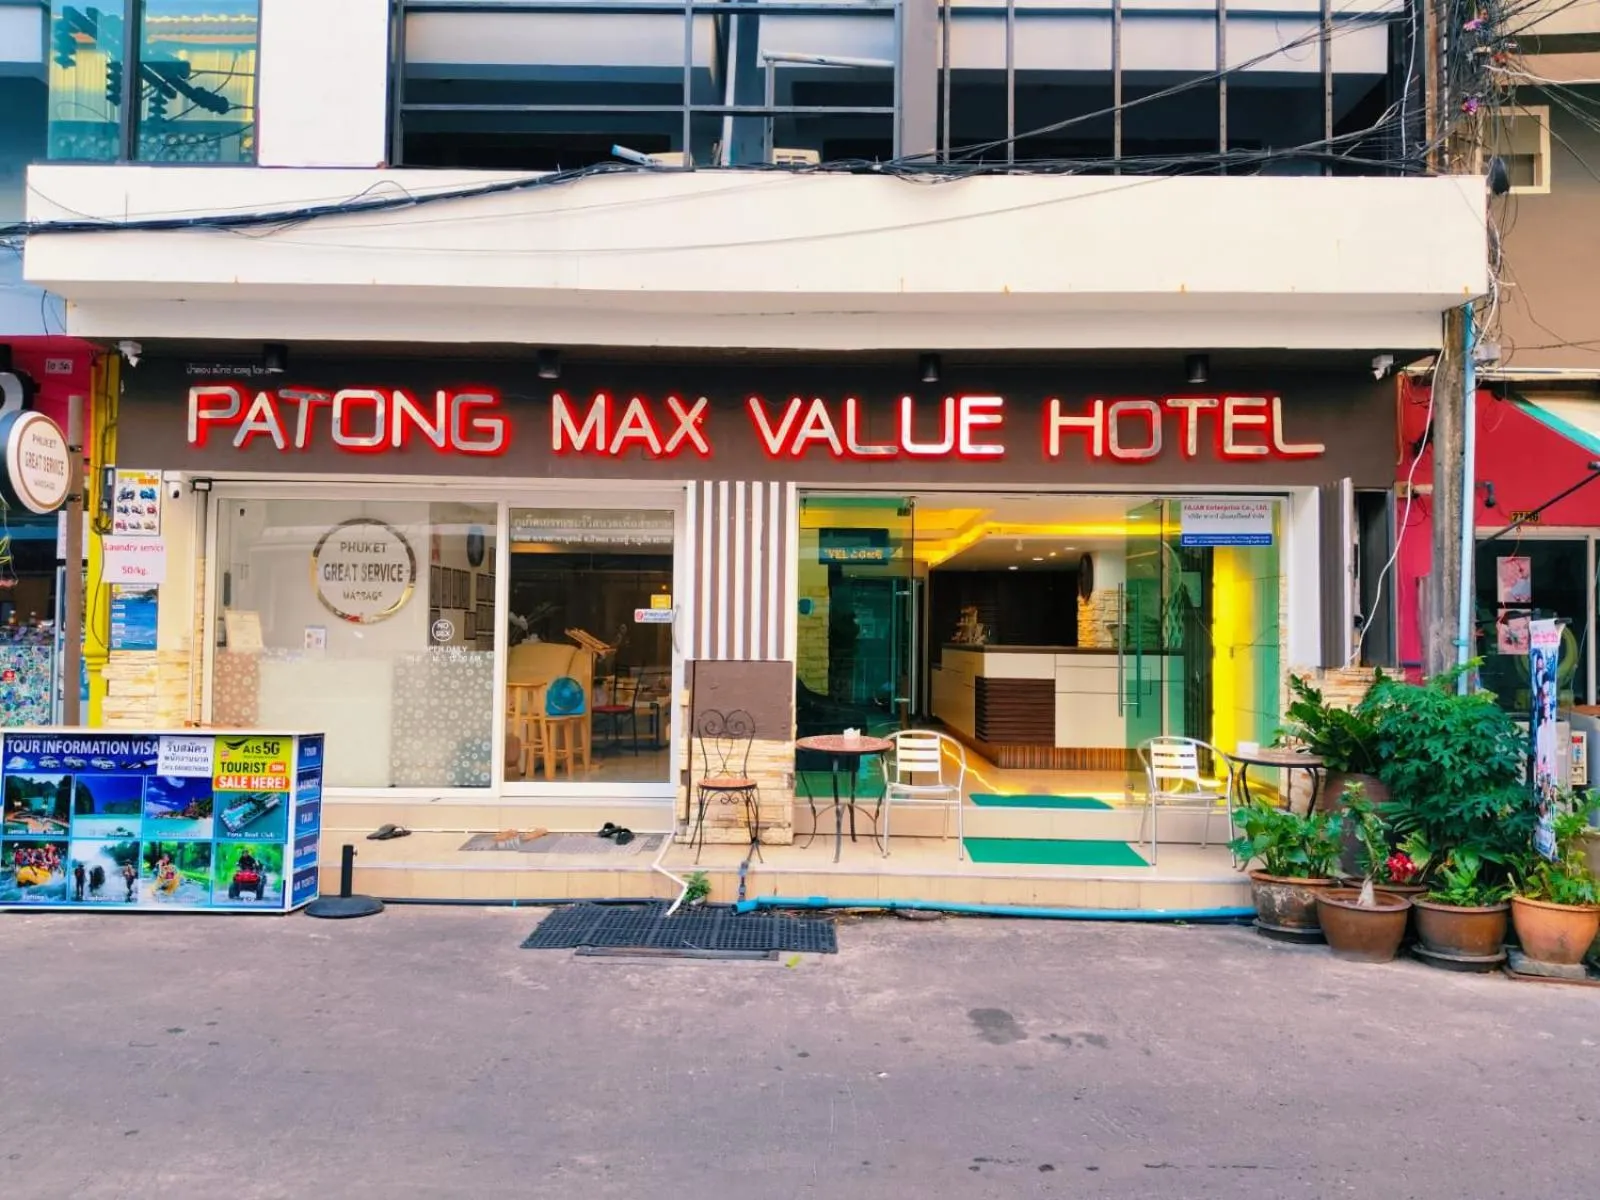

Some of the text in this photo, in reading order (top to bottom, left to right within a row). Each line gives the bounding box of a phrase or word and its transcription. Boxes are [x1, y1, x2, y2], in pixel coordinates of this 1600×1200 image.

[188, 386, 1325, 458] PATONG MAX VALUE HOTEL
[32, 433, 57, 449] PHUKET
[25, 451, 65, 477] GREAT SERVICE
[104, 543, 137, 554] Laundry
[340, 541, 387, 553] PHUKET
[324, 563, 403, 582] GREAT SERVICE
[6, 740, 159, 755] TOUR INFORMATION VISA
[166, 741, 207, 753] รับสมัคร
[243, 744, 262, 755] AIS
[263, 742, 280, 755] 5G
[220, 762, 266, 773] TOURIST
[219, 777, 286, 790] SALE HERE!
